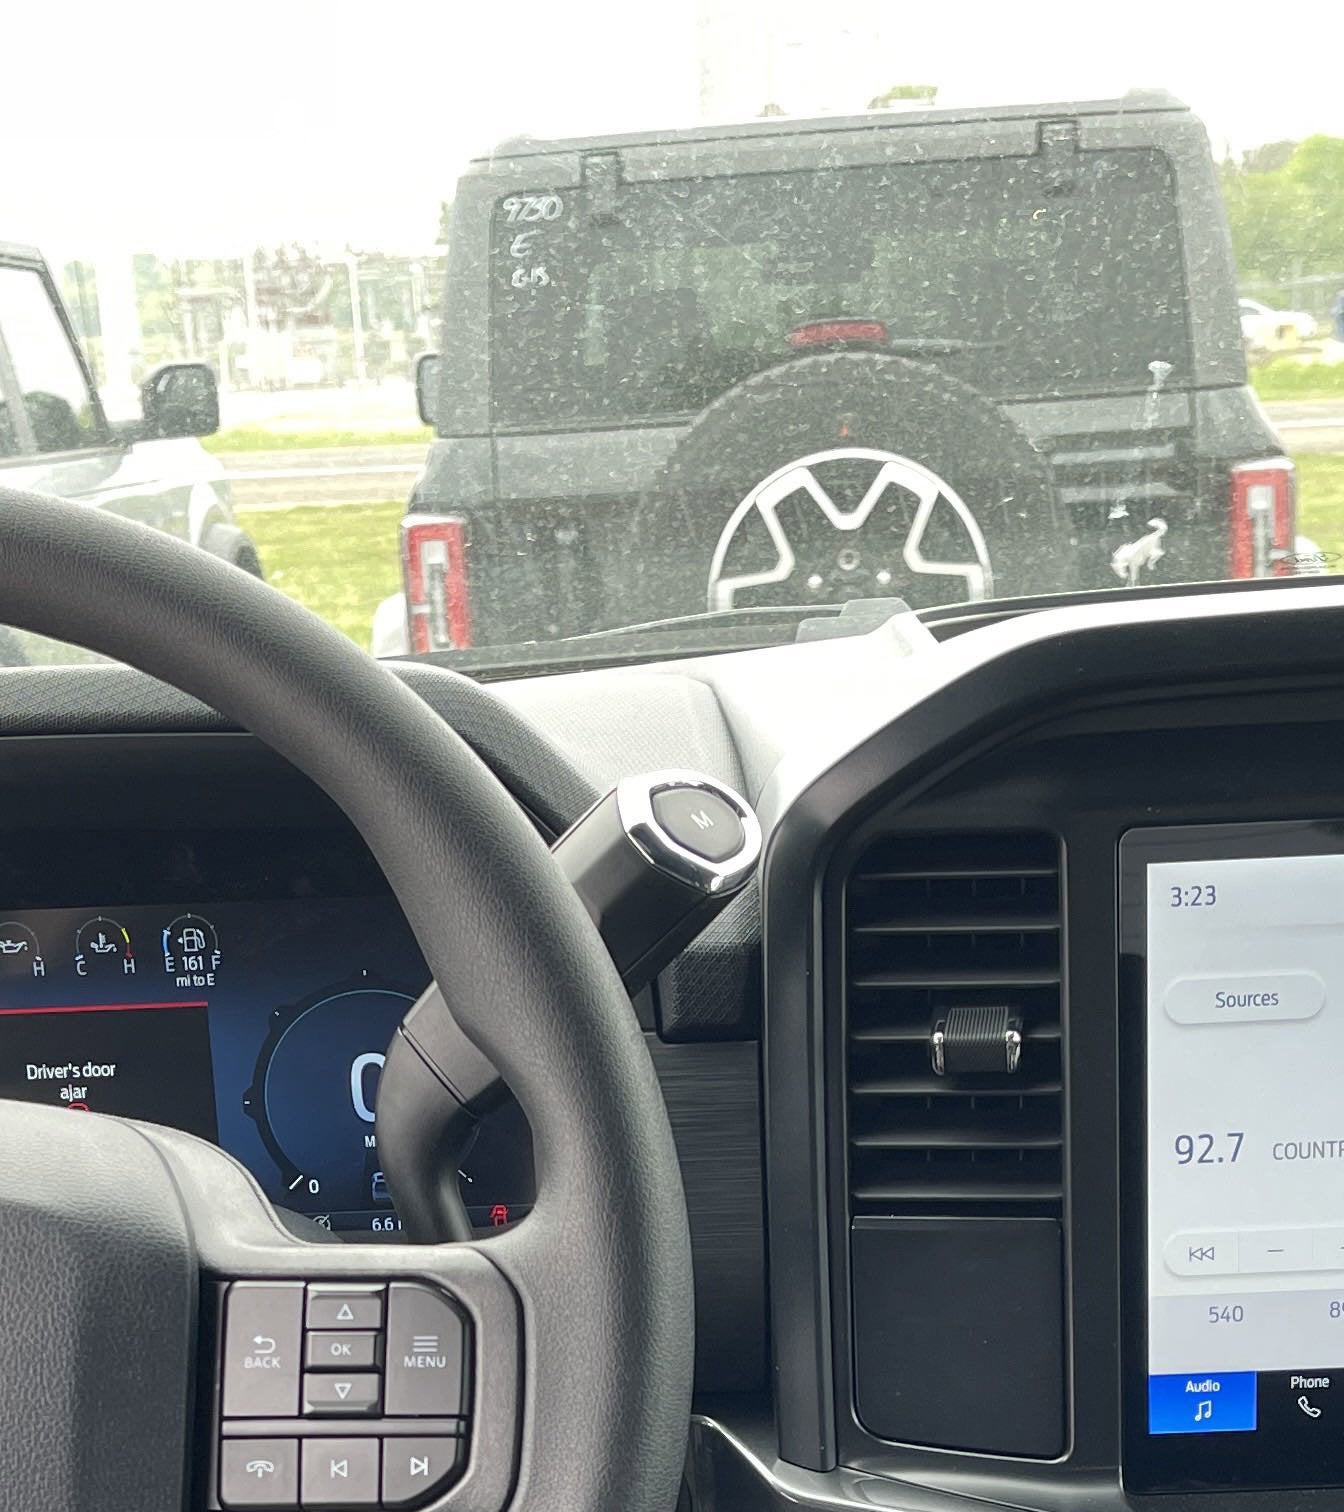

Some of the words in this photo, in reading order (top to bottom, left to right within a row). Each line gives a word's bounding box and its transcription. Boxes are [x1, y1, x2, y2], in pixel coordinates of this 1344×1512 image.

[1169, 885, 1217, 908] 3:23
[182, 955, 204, 971] 161
[1215, 991, 1279, 1010] Sources
[26, 1063, 81, 1081] Driver's
[82, 1061, 116, 1078] door
[60, 1085, 87, 1103] ajar
[1174, 1132, 1245, 1165] 92.7
[308, 1178, 320, 1194] 0
[371, 1217, 394, 1231] 6.6
[1208, 1305, 1244, 1324] 540
[331, 1342, 352, 1357] OK
[244, 1356, 281, 1369] BACK
[404, 1355, 447, 1369] MENU
[1185, 1379, 1221, 1394] Audio
[1289, 1374, 1331, 1391] Phone
